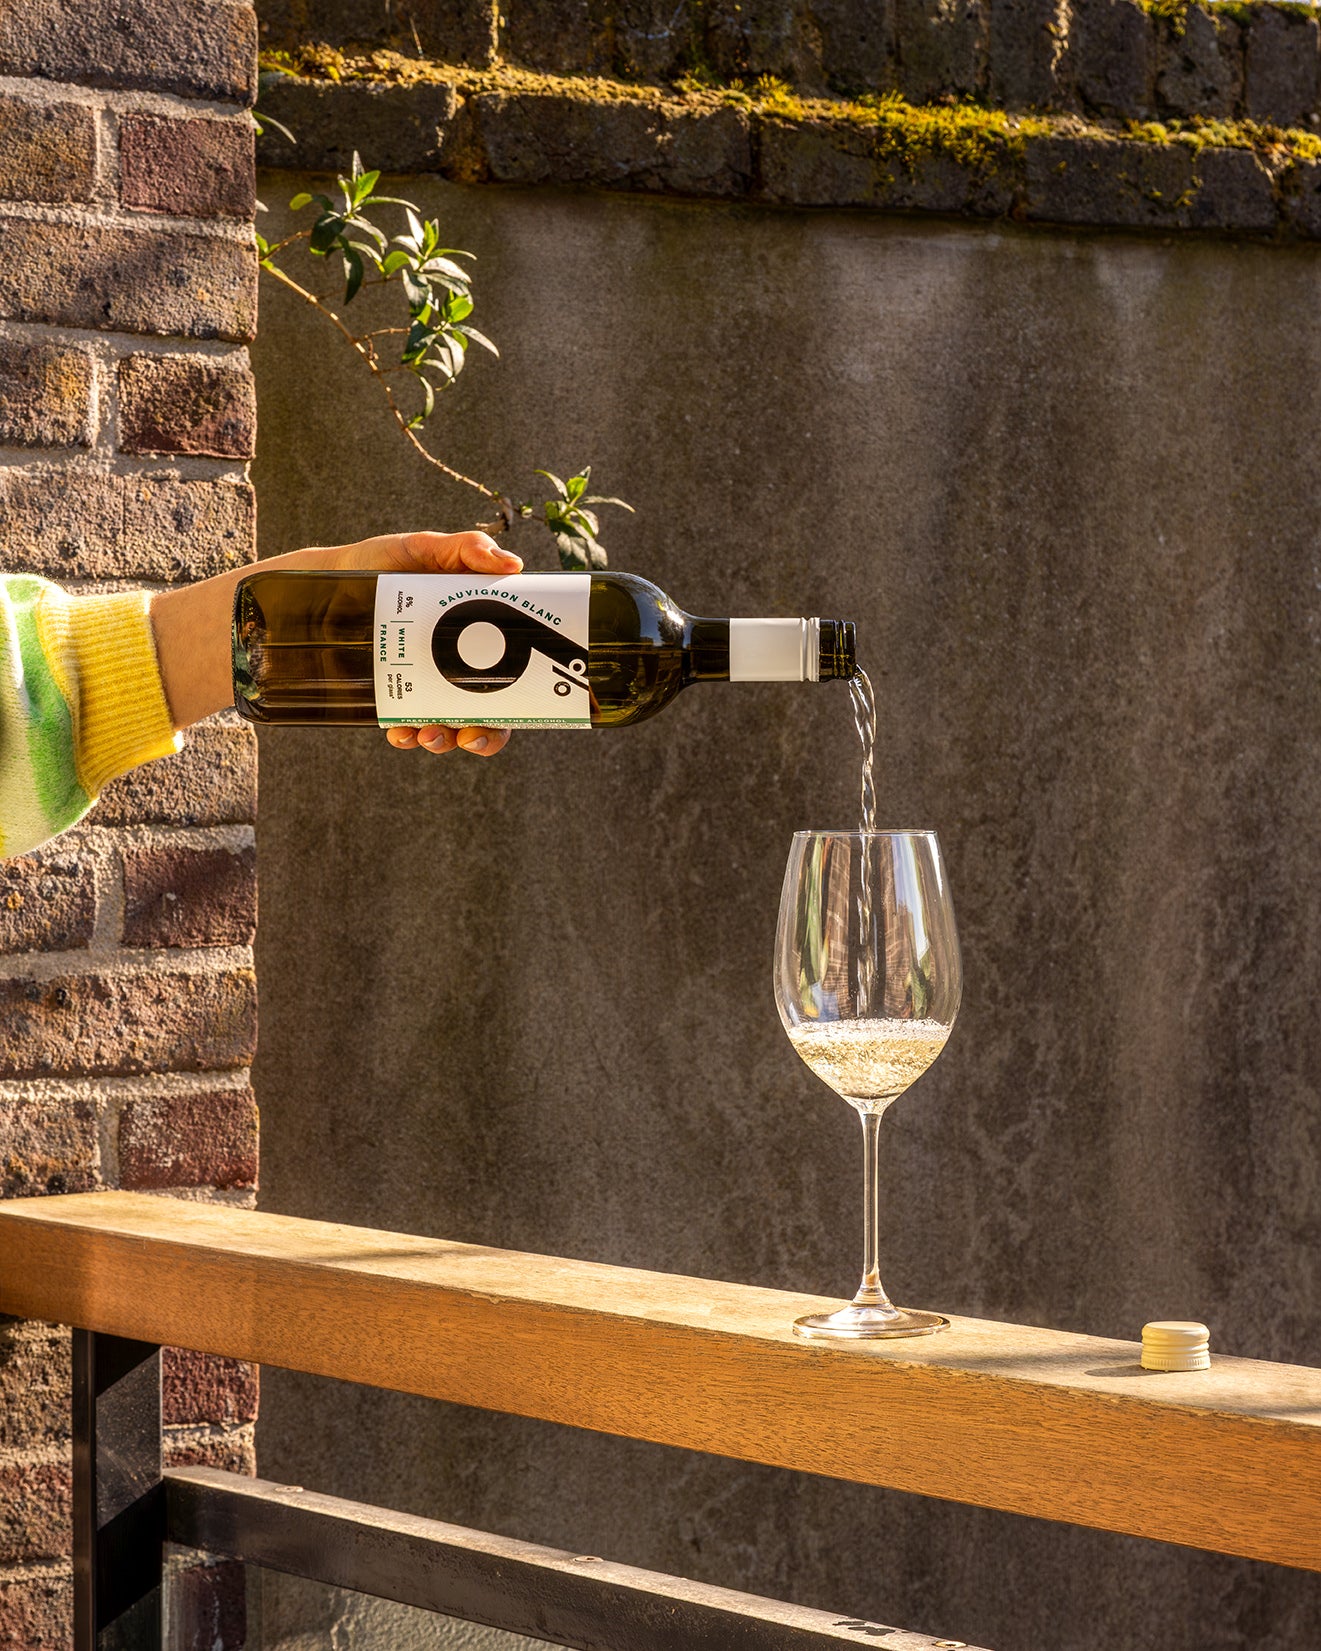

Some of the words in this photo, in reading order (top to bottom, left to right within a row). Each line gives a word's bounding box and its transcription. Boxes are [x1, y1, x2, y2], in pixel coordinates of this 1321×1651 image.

[396, 590, 404, 615] ALCOHOL
[405, 596, 414, 608] 6%
[438, 588, 519, 607] SAUVIGNON
[521, 600, 563, 626] BLANC
[404, 681, 413, 692] 53
